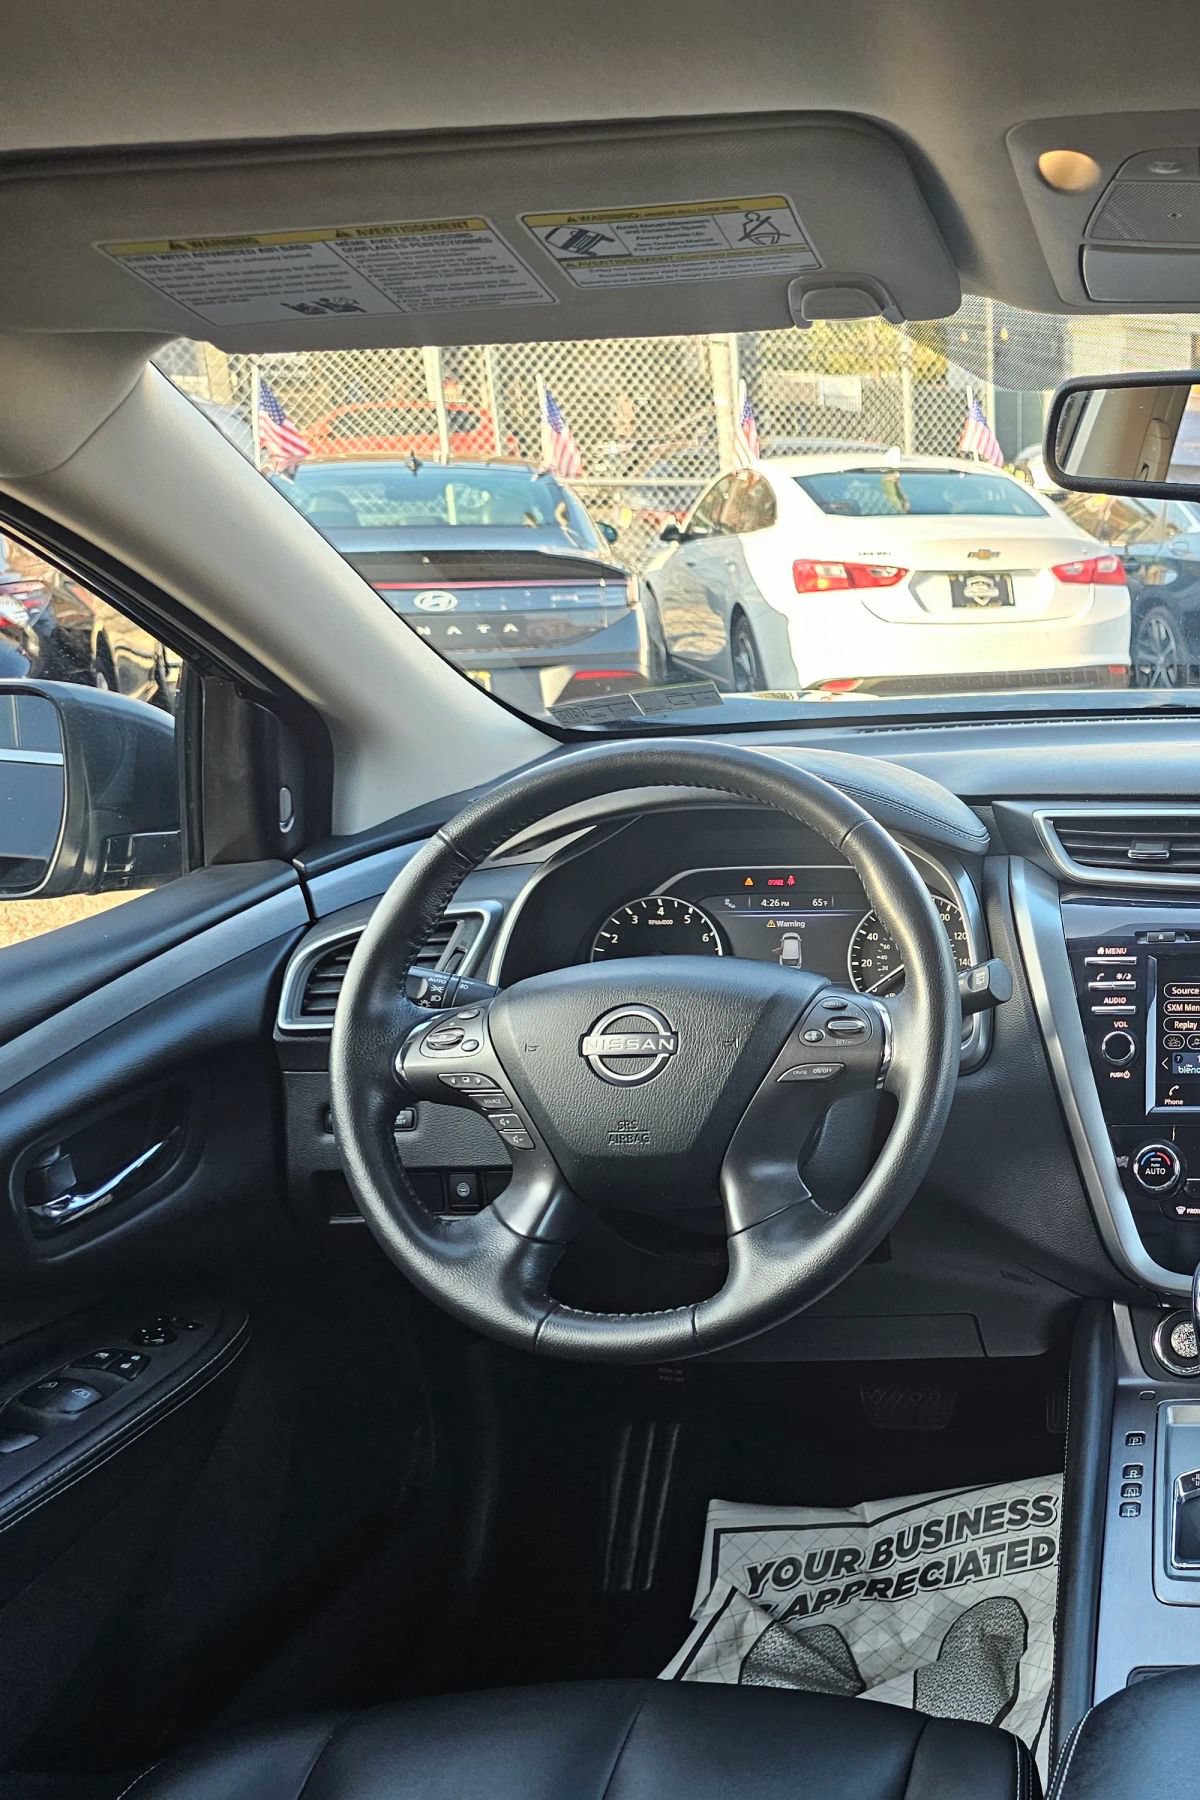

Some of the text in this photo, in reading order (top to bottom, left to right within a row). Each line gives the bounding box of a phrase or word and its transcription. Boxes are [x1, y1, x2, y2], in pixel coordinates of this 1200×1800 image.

[416, 622, 519, 636] NATA
[760, 898, 780, 908] 4:26
[656, 906, 665, 916] 4
[631, 915, 639, 925] 3
[683, 914, 691, 924] 5
[776, 919, 806, 929] Warning
[610, 934, 619, 944] 2
[701, 933, 710, 943] 6
[866, 932, 879, 942] 40
[953, 932, 968, 941] 120
[1104, 947, 1128, 955] MENU
[860, 959, 873, 968] 20
[1171, 986, 1200, 995] Source
[1167, 1003, 1183, 1012] SXM
[1173, 1020, 1198, 1030] Replay
[585, 1037, 675, 1052] NISSAN
[616, 1120, 639, 1132] SRS
[608, 1133, 651, 1146] AIRBAG
[1145, 1167, 1166, 1175] AUTO
[745, 1494, 1060, 1597] YOUR BUSINESS
